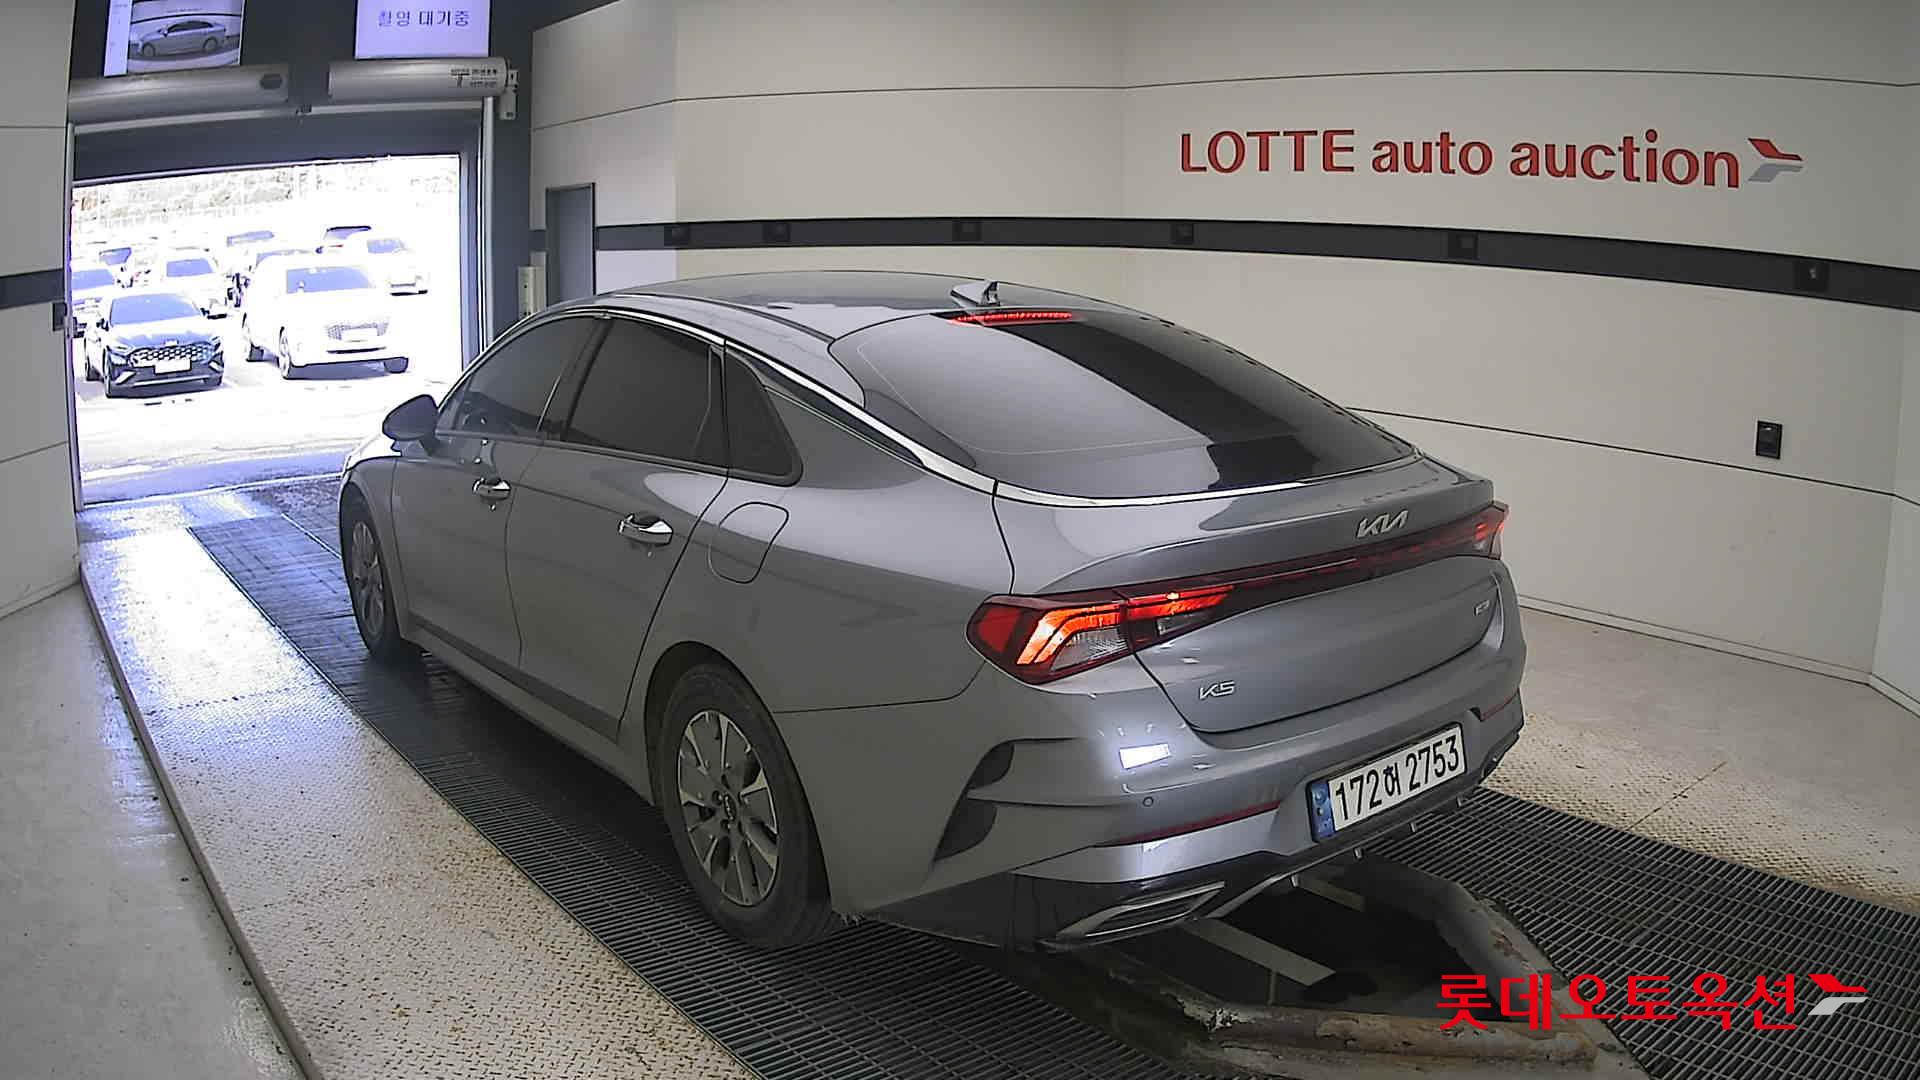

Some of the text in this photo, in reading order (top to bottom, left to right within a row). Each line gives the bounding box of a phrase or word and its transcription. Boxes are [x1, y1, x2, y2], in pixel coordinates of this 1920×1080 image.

[419, 9, 469, 27] 대기중
[1180, 128, 1740, 189] LOTTE auto auction
[1199, 680, 1235, 700] K5
